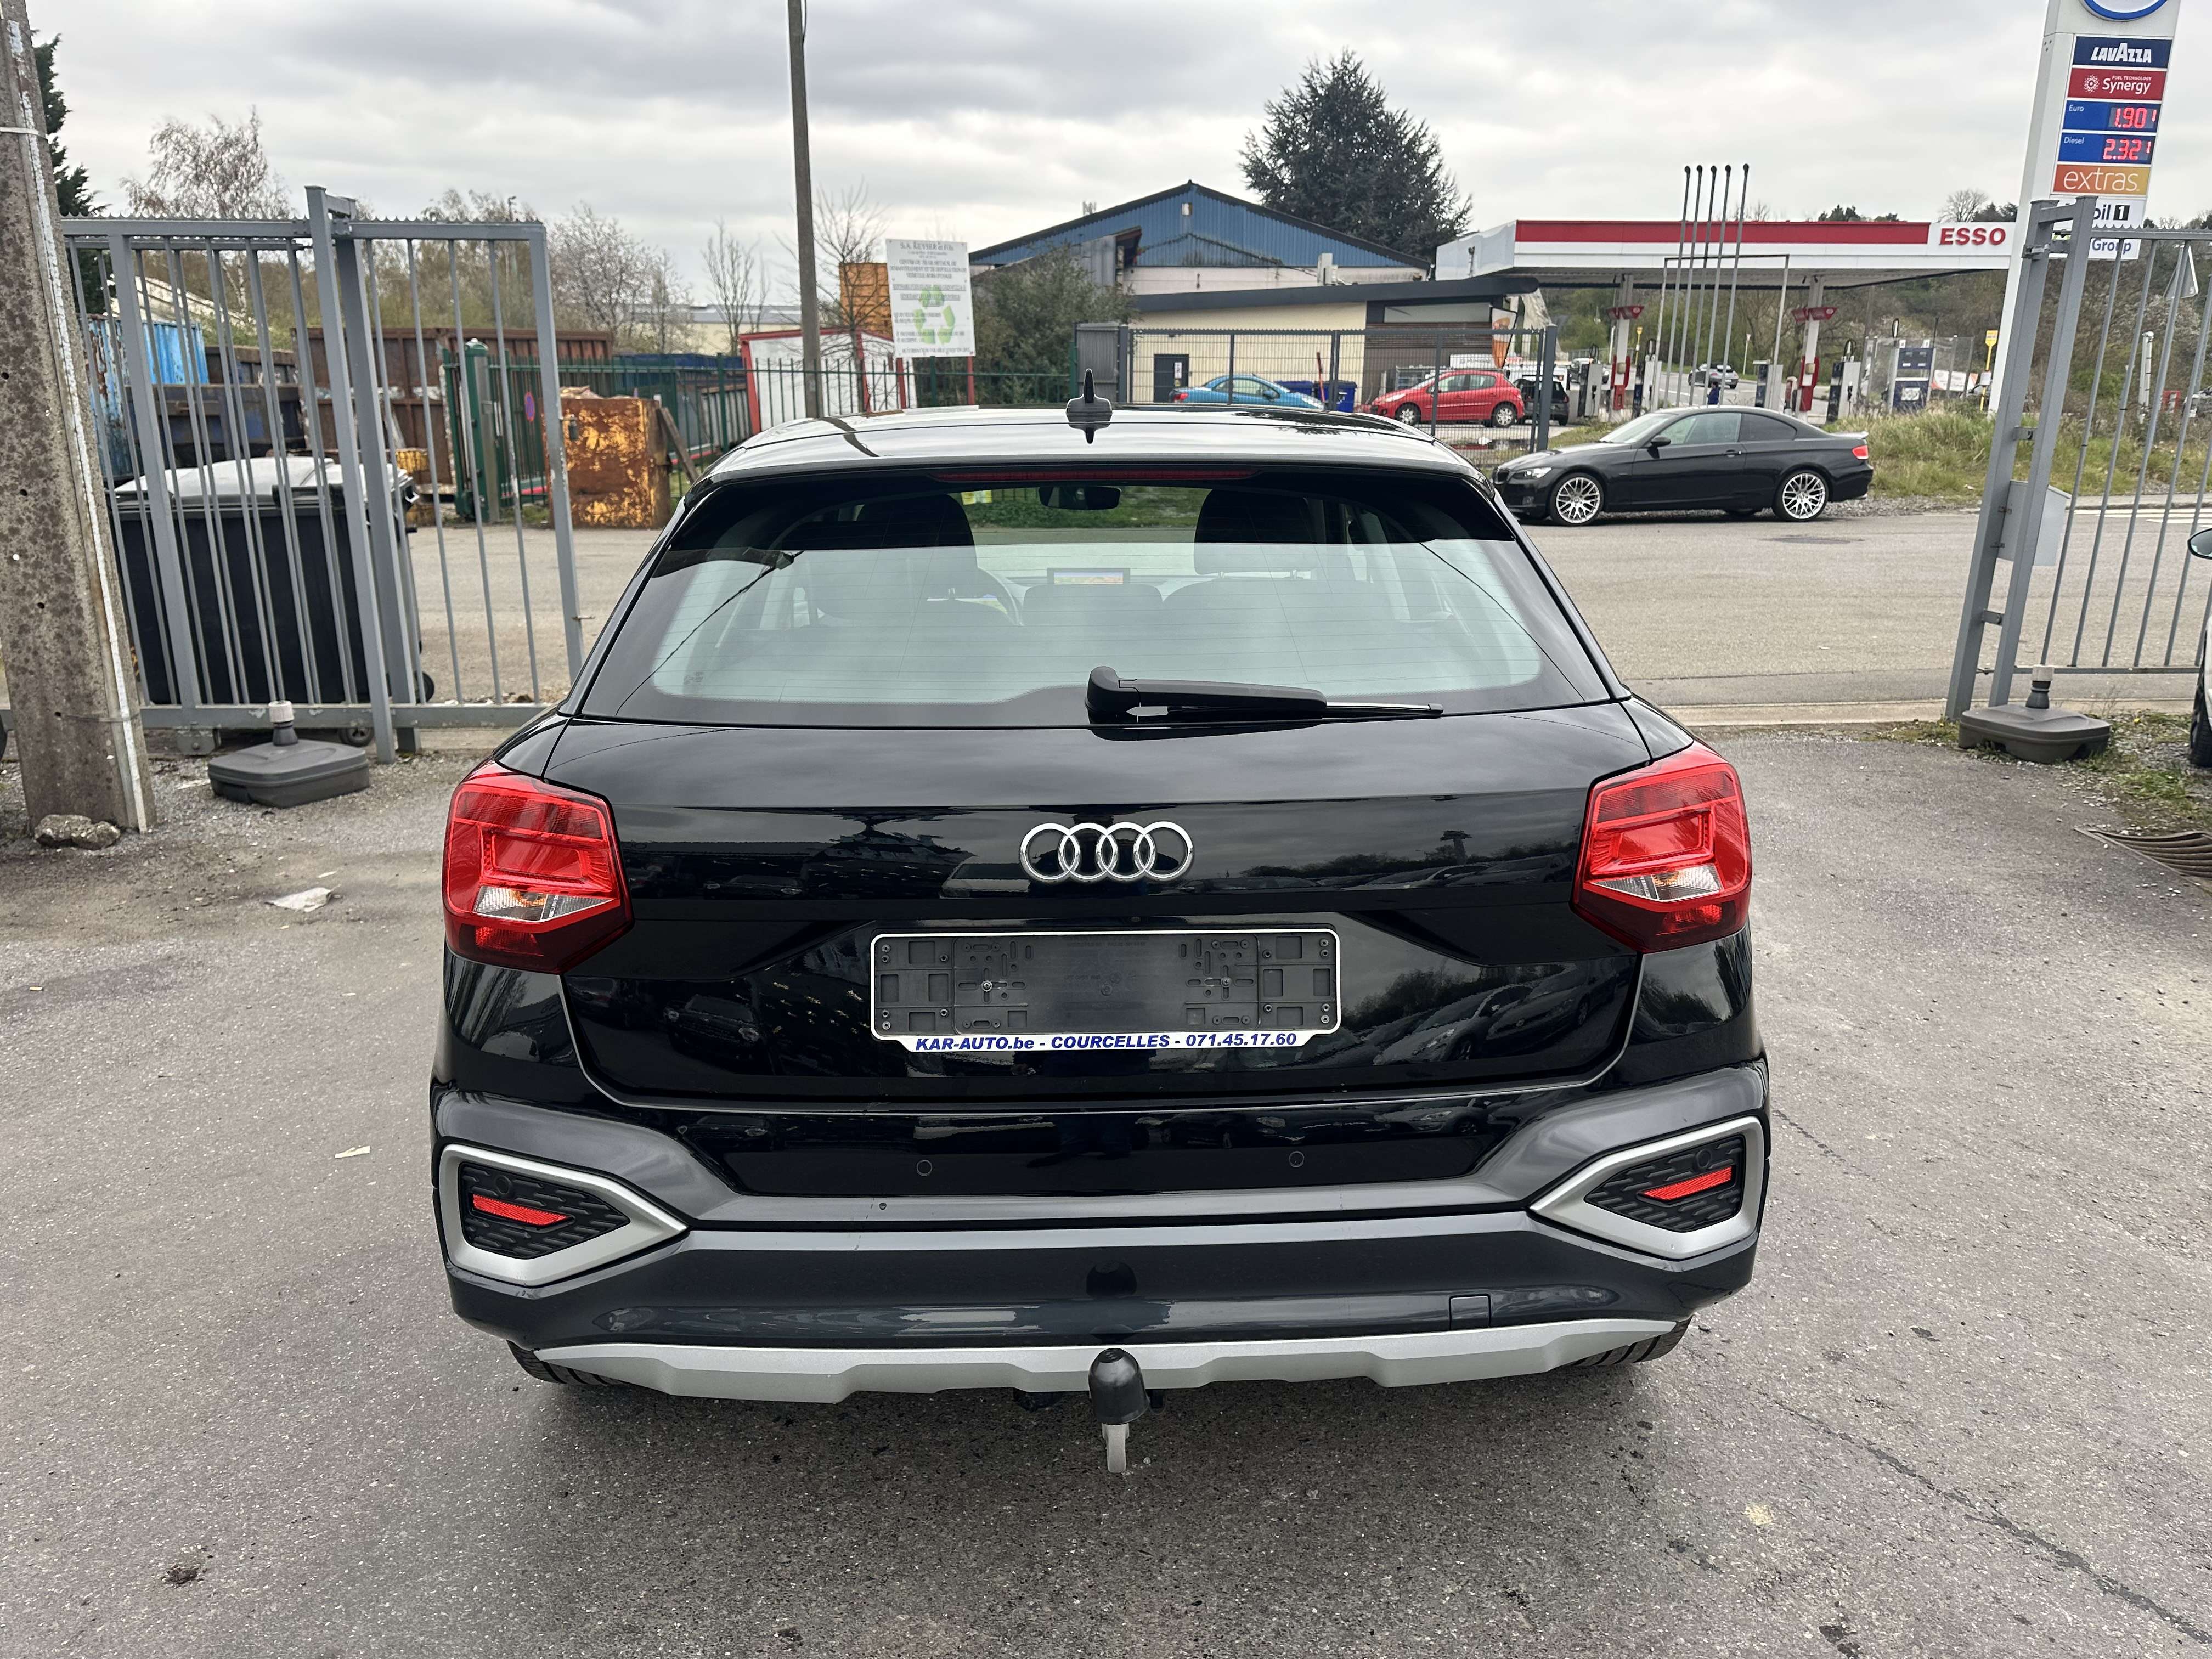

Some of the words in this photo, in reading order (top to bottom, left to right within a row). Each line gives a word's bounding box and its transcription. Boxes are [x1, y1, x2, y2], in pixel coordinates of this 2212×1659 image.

[2091, 43, 2152, 63] LAVAZZA
[2102, 78, 2151, 95] Synergy
[2063, 167, 2138, 191] extras
[1939, 228, 2006, 245] ESSO
[916, 1037, 1034, 1050] KAR-AUTO.be
[1051, 1035, 1169, 1048] COURCELLES
[1186, 1033, 1296, 1046] 071.45.17.60
